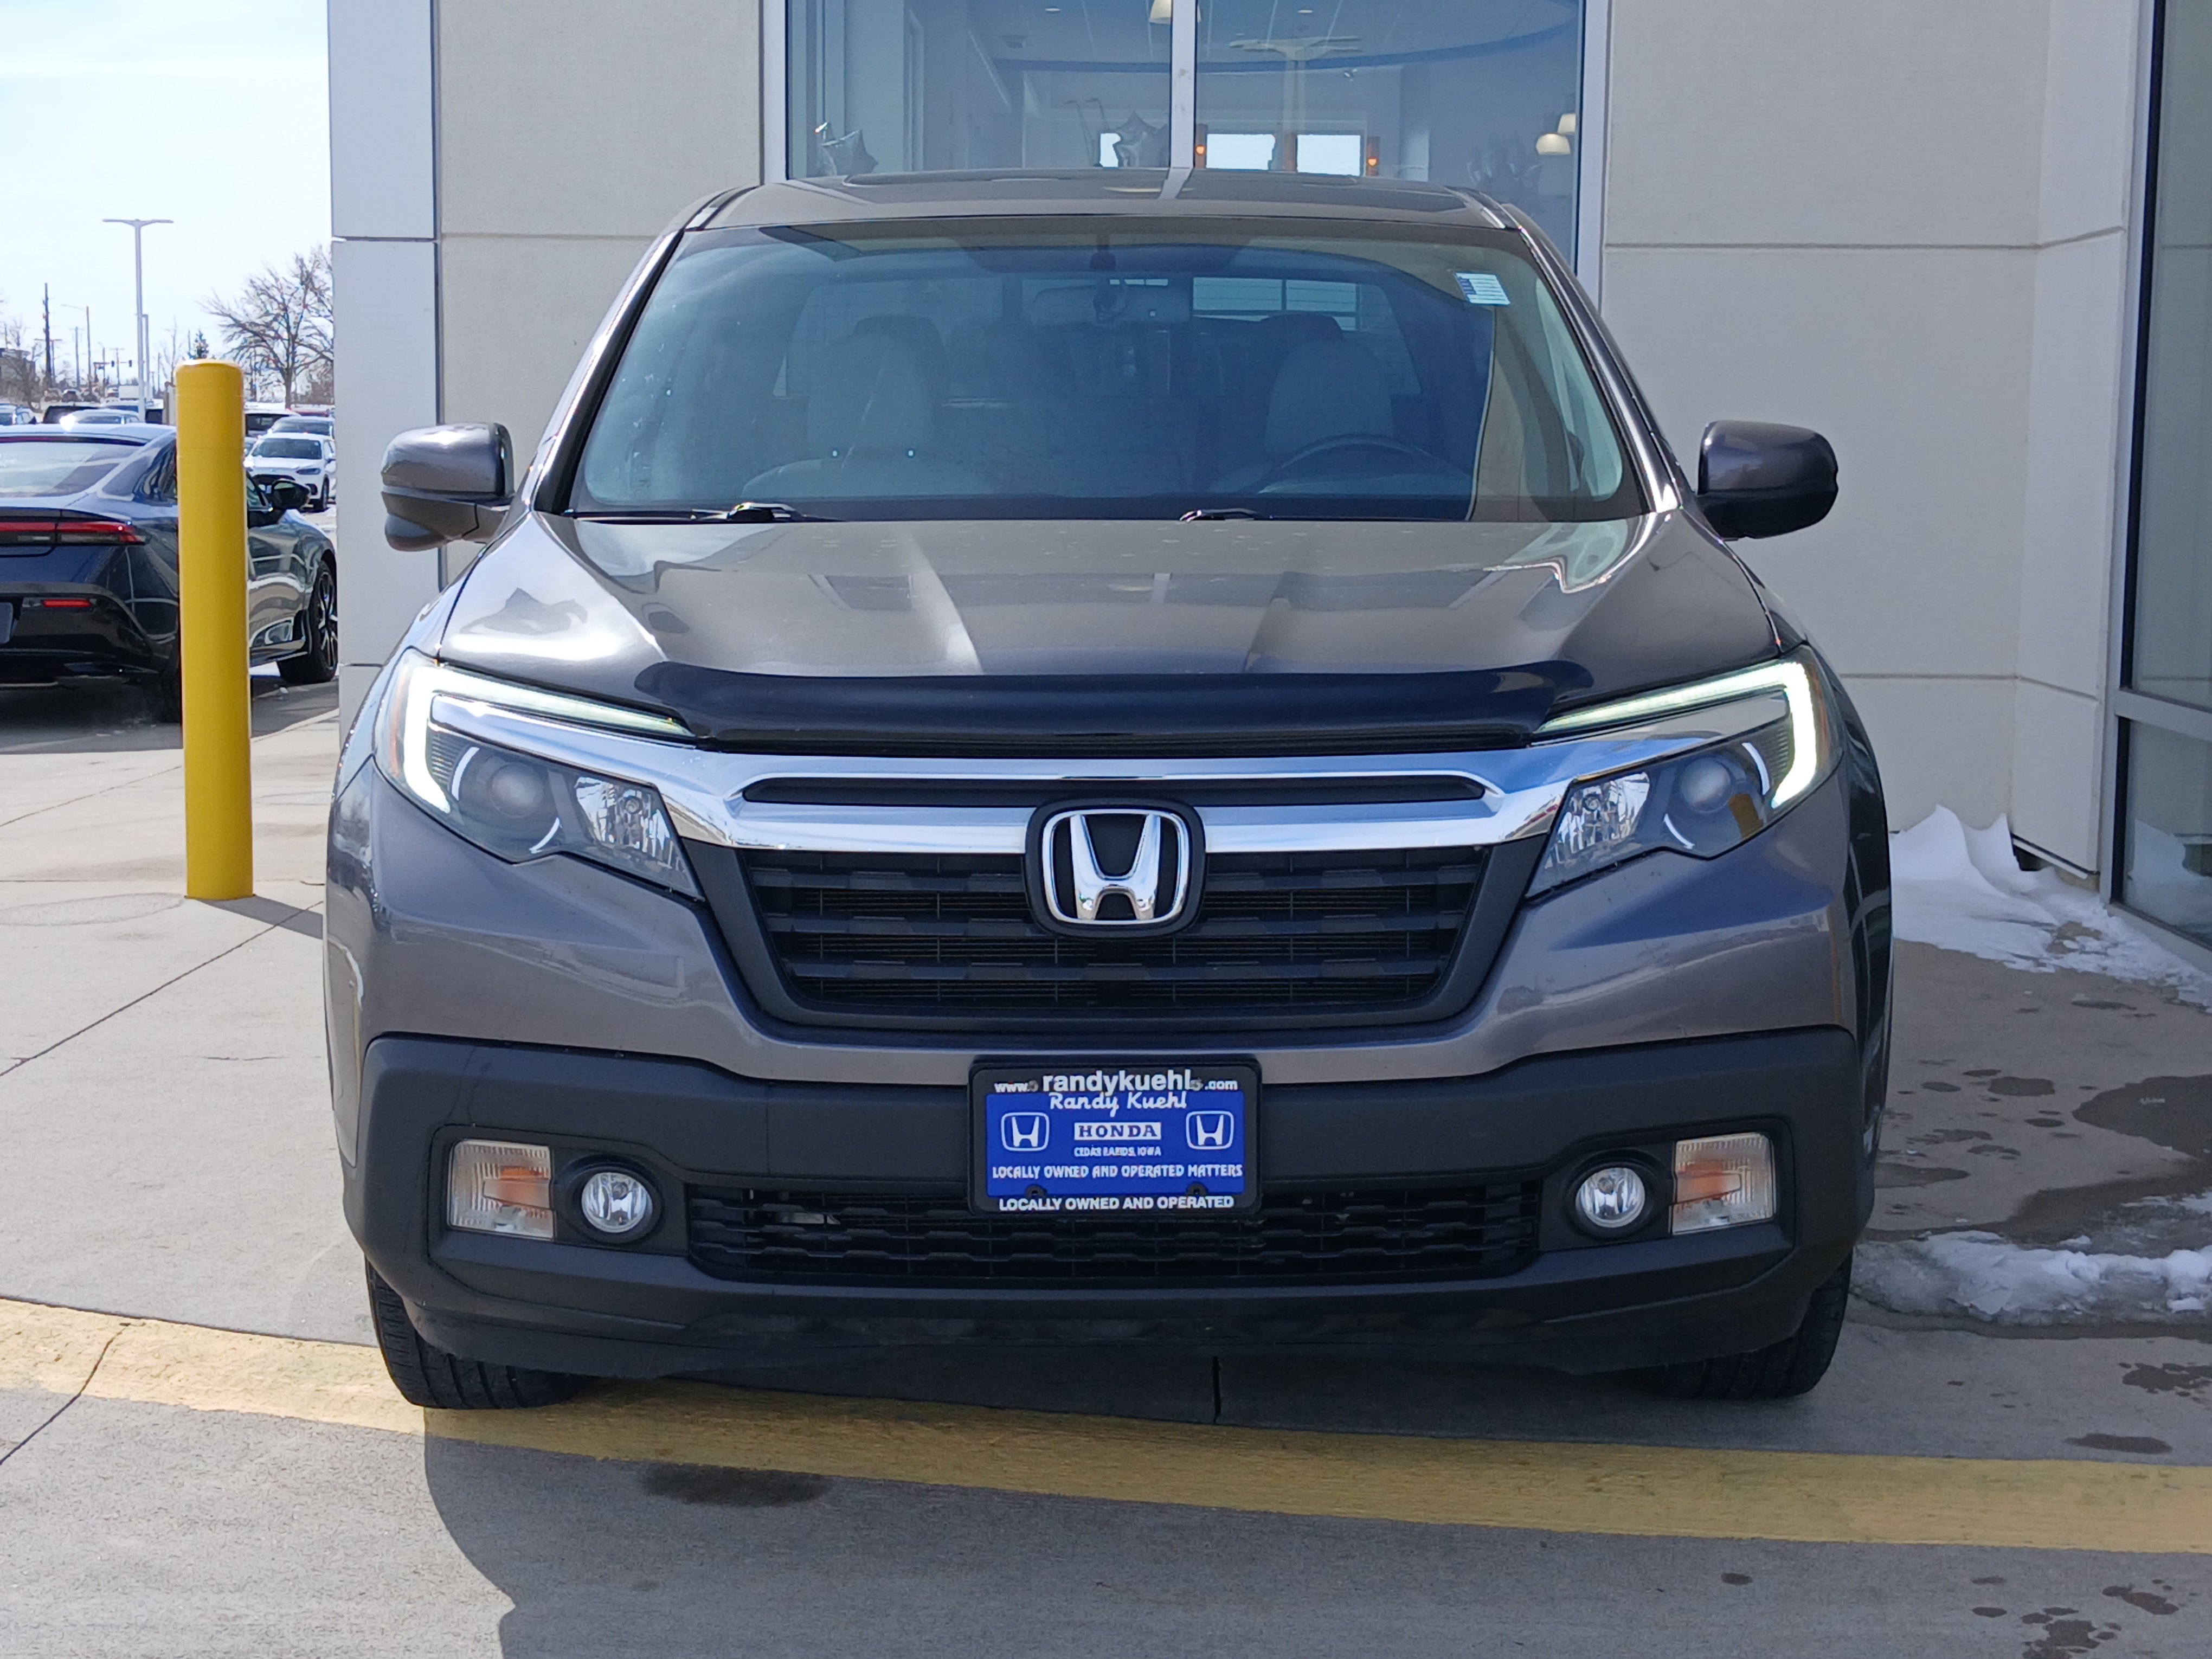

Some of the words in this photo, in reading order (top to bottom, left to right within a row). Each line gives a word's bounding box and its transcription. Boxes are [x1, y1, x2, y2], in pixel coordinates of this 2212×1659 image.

[1043, 1069, 1191, 1096] randykuehl
[1049, 1091, 1120, 1117] Randy
[1127, 1091, 1187, 1109] Kuehl
[1078, 1124, 1158, 1137] HONDA
[993, 1166, 1040, 1179] LOCALLY
[1044, 1166, 1089, 1178] OWNED
[1092, 1165, 1118, 1179] AND
[1121, 1165, 1185, 1178] OPERATED
[1187, 1164, 1243, 1178] MATTERS
[999, 1198, 1063, 1211] LOCALLY
[1065, 1197, 1120, 1210] OWNED
[1122, 1197, 1154, 1210] AND
[1156, 1195, 1234, 1209] OPERATED
